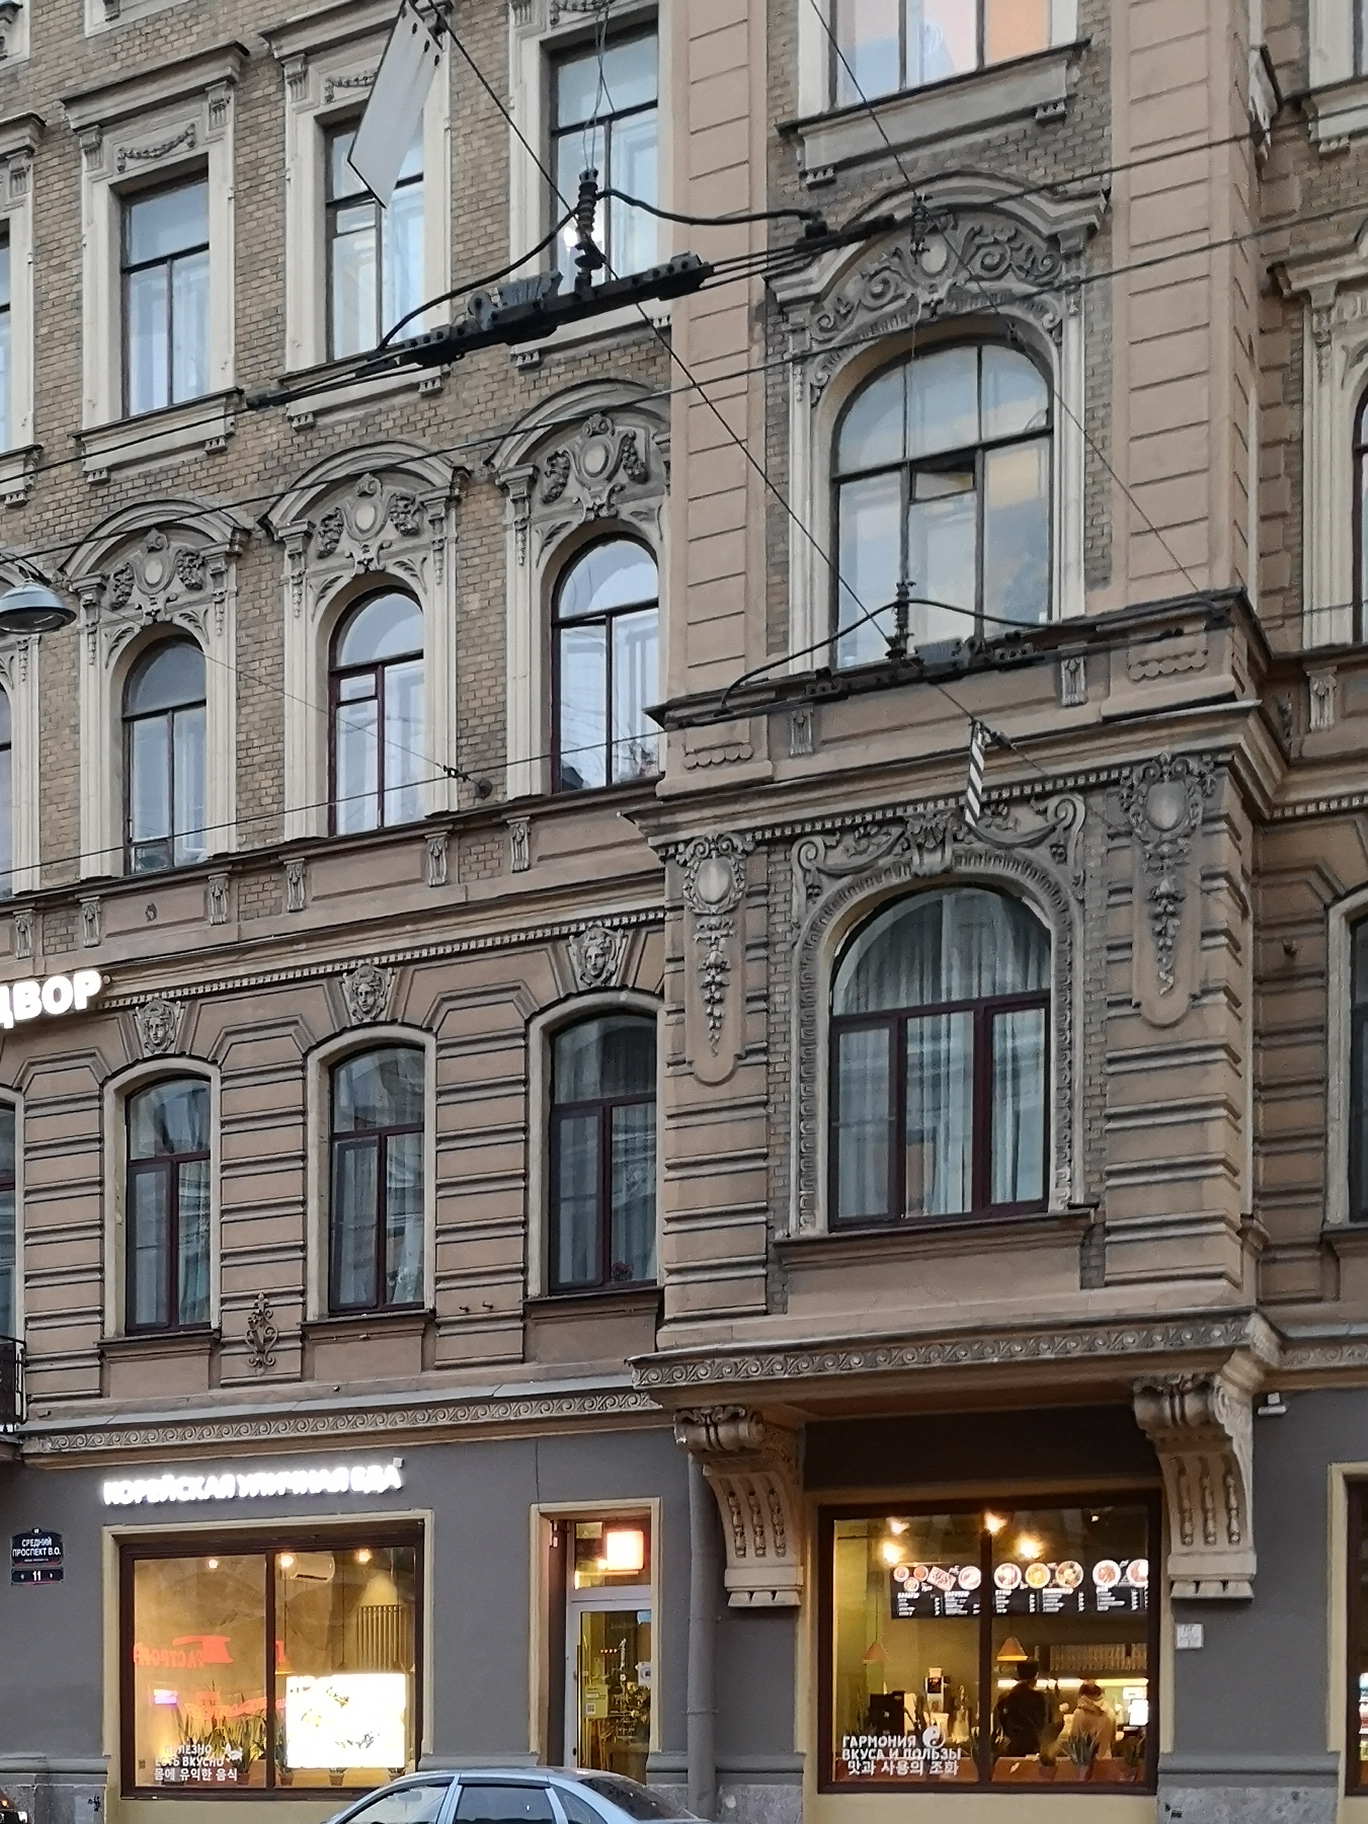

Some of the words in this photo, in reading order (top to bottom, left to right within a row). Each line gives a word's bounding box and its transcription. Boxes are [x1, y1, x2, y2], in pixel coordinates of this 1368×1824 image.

[21, 1536, 52, 1547] СРЕДНИЙ
[12, 1548, 47, 1557] ПРОСПЕКТ
[48, 1547, 62, 1556] В.О.
[32, 1570, 41, 1581] 11
[842, 1735, 917, 1748] ГАРМОНИЯ
[164, 1744, 212, 1755] ПЛЕЗНО
[842, 1748, 885, 1760] ВКУСА
[889, 1748, 899, 1760] И
[903, 1748, 962, 1760] ПОЛЬЗЫ
[182, 1756, 225, 1767] ВКУСНО
[847, 1760, 876, 1776] 맛과
[929, 1760, 959, 1776] 조화
[215, 1768, 238, 1781] 음식
